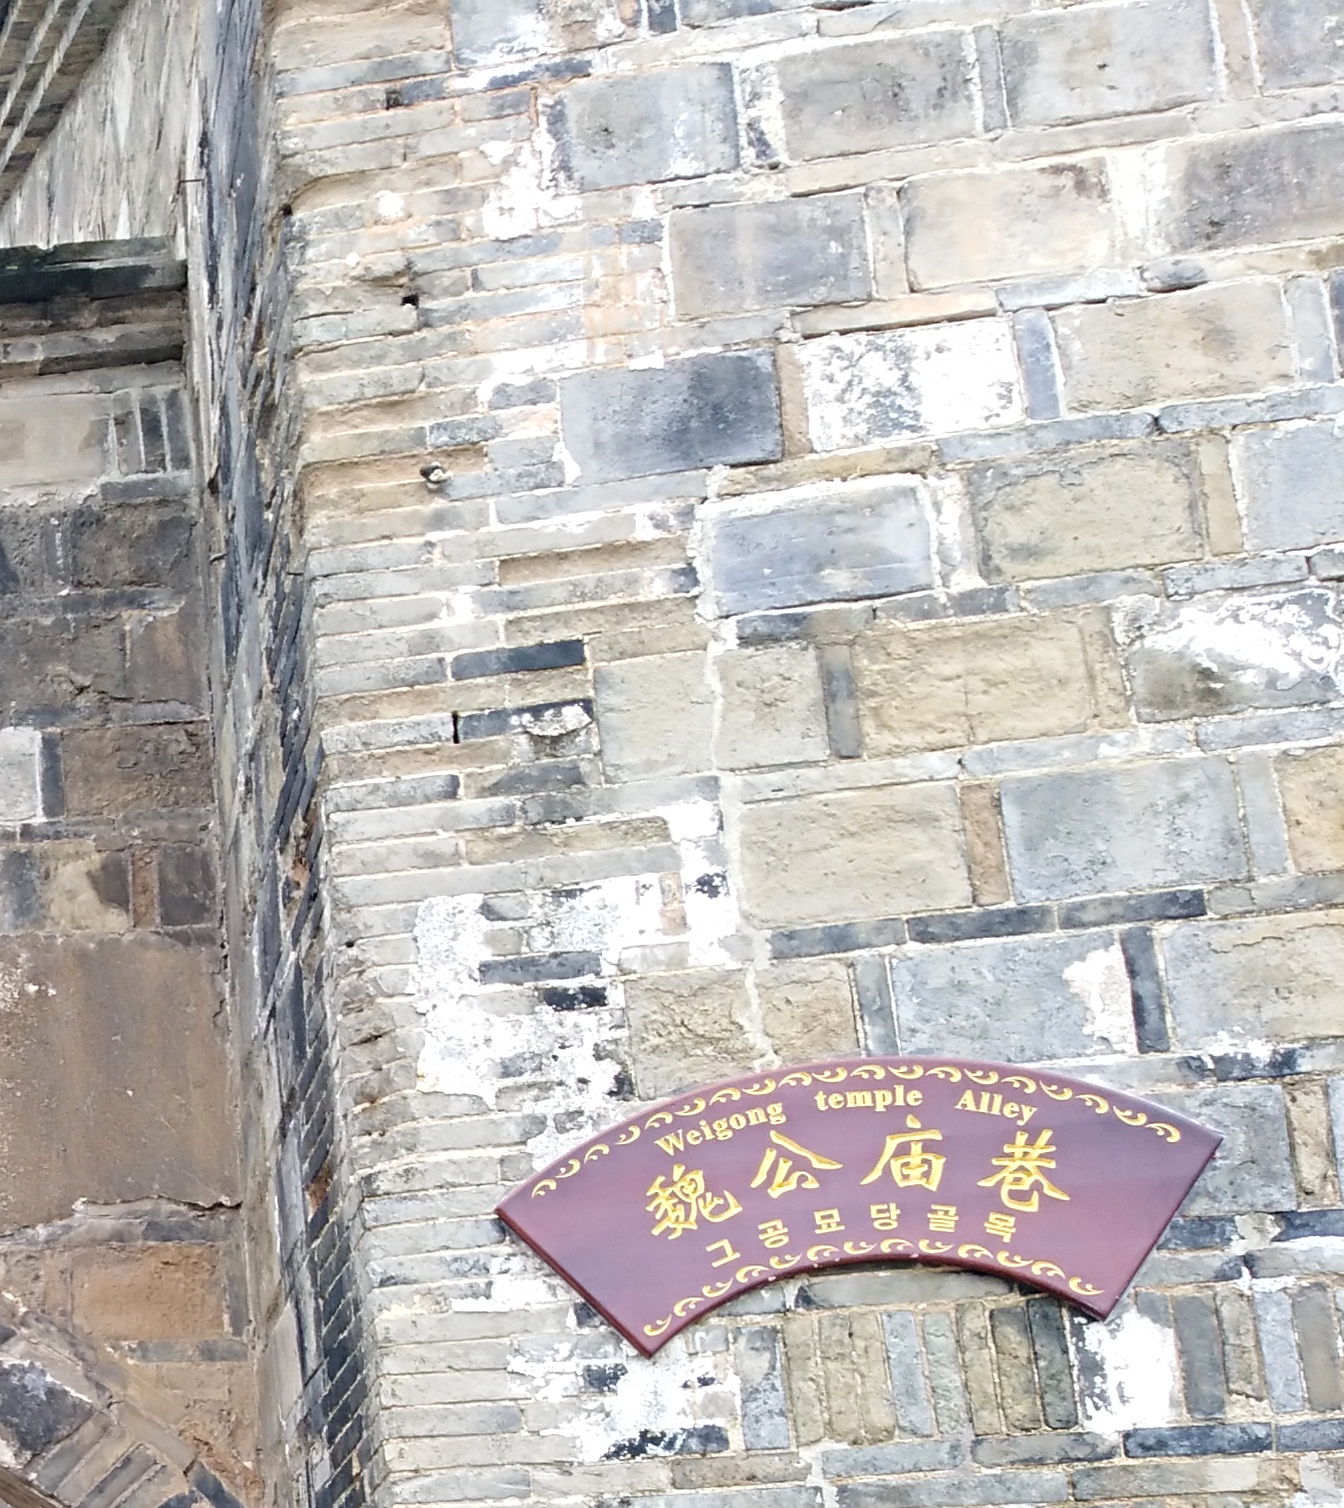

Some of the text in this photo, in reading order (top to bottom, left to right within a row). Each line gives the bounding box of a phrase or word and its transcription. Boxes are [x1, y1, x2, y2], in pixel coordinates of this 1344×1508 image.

[653, 1083, 1038, 1156] Weigong temple Alley
[643, 1116, 1071, 1240] 魏公庙巷
